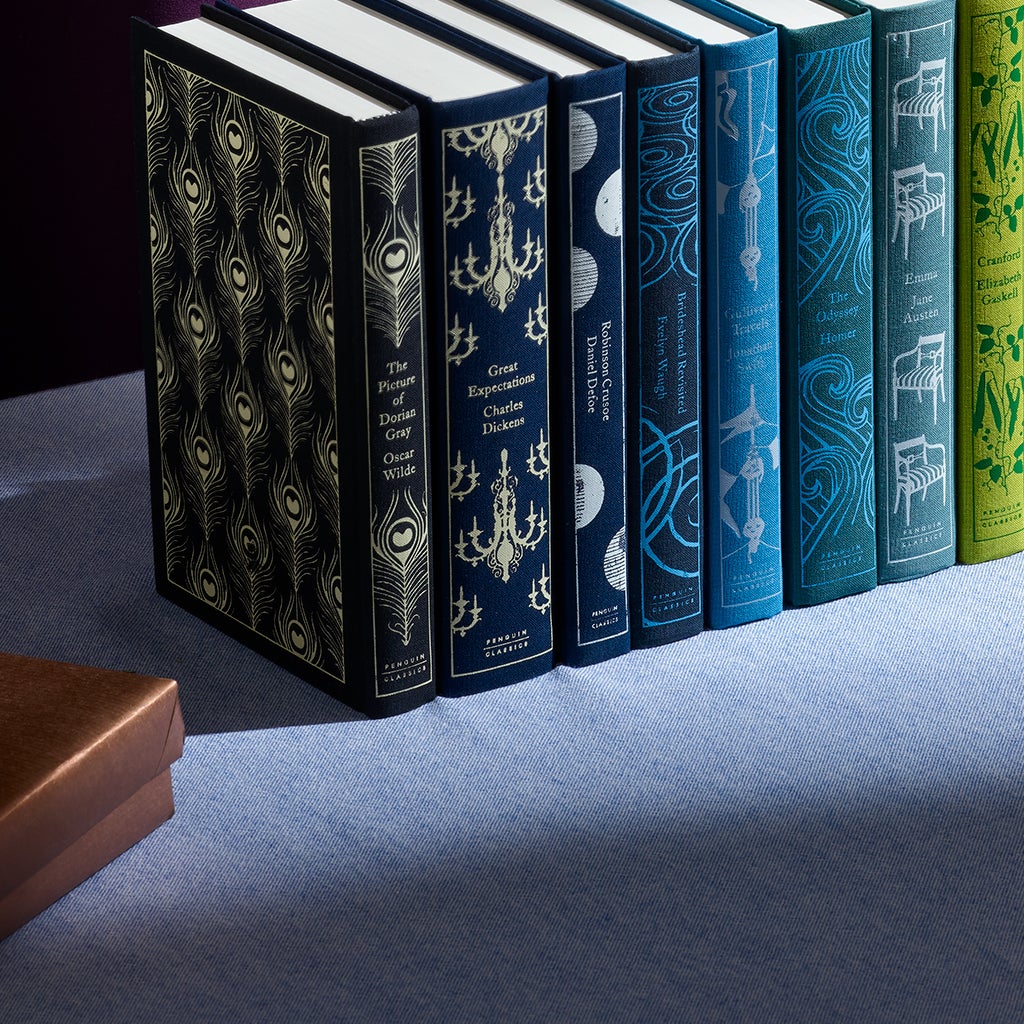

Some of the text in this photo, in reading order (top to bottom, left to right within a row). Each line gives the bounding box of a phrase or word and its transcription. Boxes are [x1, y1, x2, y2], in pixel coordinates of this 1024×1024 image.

[977, 247, 1021, 267] Cranford
[905, 271, 938, 285] Emma
[976, 271, 1021, 291] Elizabeth
[828, 291, 849, 304] The
[910, 295, 932, 310] Jane
[981, 287, 1018, 306] Gaskell
[815, 305, 859, 323] Odyssey
[903, 308, 939, 324] Austen
[819, 329, 857, 345] Homer
[653, 316, 668, 400] Evelyn Waugh
[677, 291, 688, 415] Brideshead Revisited
[386, 361, 409, 375] The
[488, 361, 519, 377] Great
[586, 336, 599, 414] Daniel Defoe
[601, 320, 613, 422] Robinson Crusoe
[377, 375, 417, 393] Picture
[467, 373, 536, 398] Expectations
[392, 391, 406, 407] of
[379, 408, 417, 426] Dorian
[483, 400, 524, 418] Charles
[385, 426, 412, 441] Gray
[482, 416, 526, 436] Dickens
[383, 449, 415, 465] Oscar
[382, 463, 417, 481] Wilde
[486, 629, 527, 646] PENGUIN
[485, 641, 528, 658] CLASSICS
[384, 653, 425, 670] PENGUIN
[383, 665, 426, 683] CLASSICS
